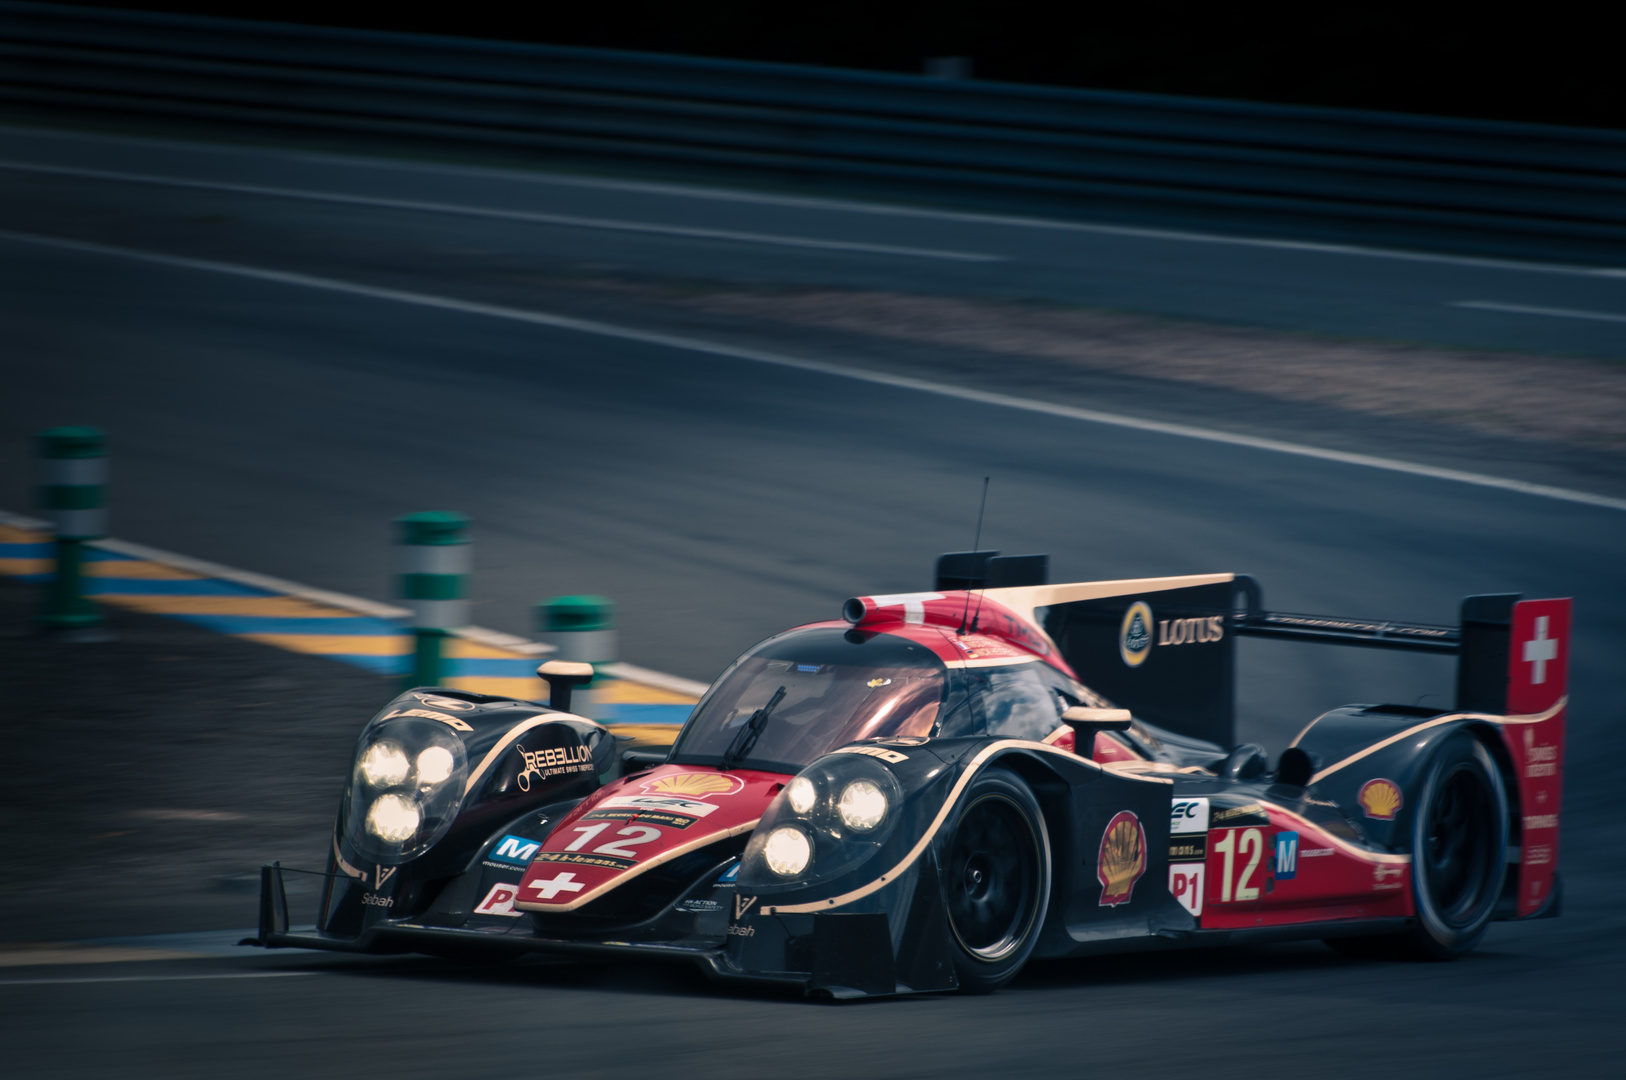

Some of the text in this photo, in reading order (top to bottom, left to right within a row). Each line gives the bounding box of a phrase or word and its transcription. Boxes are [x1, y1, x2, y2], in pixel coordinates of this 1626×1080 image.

[1157, 615, 1224, 646] LOTUS
[524, 744, 593, 770] REBELLION
[544, 766, 566, 777] ULTIMATE
[495, 838, 540, 861] M
[563, 822, 662, 858] 12
[1213, 827, 1263, 903] 12
[1277, 839, 1297, 874] M
[361, 892, 395, 908] Sebah
[482, 889, 516, 913] P
[1173, 872, 1199, 909] P1
